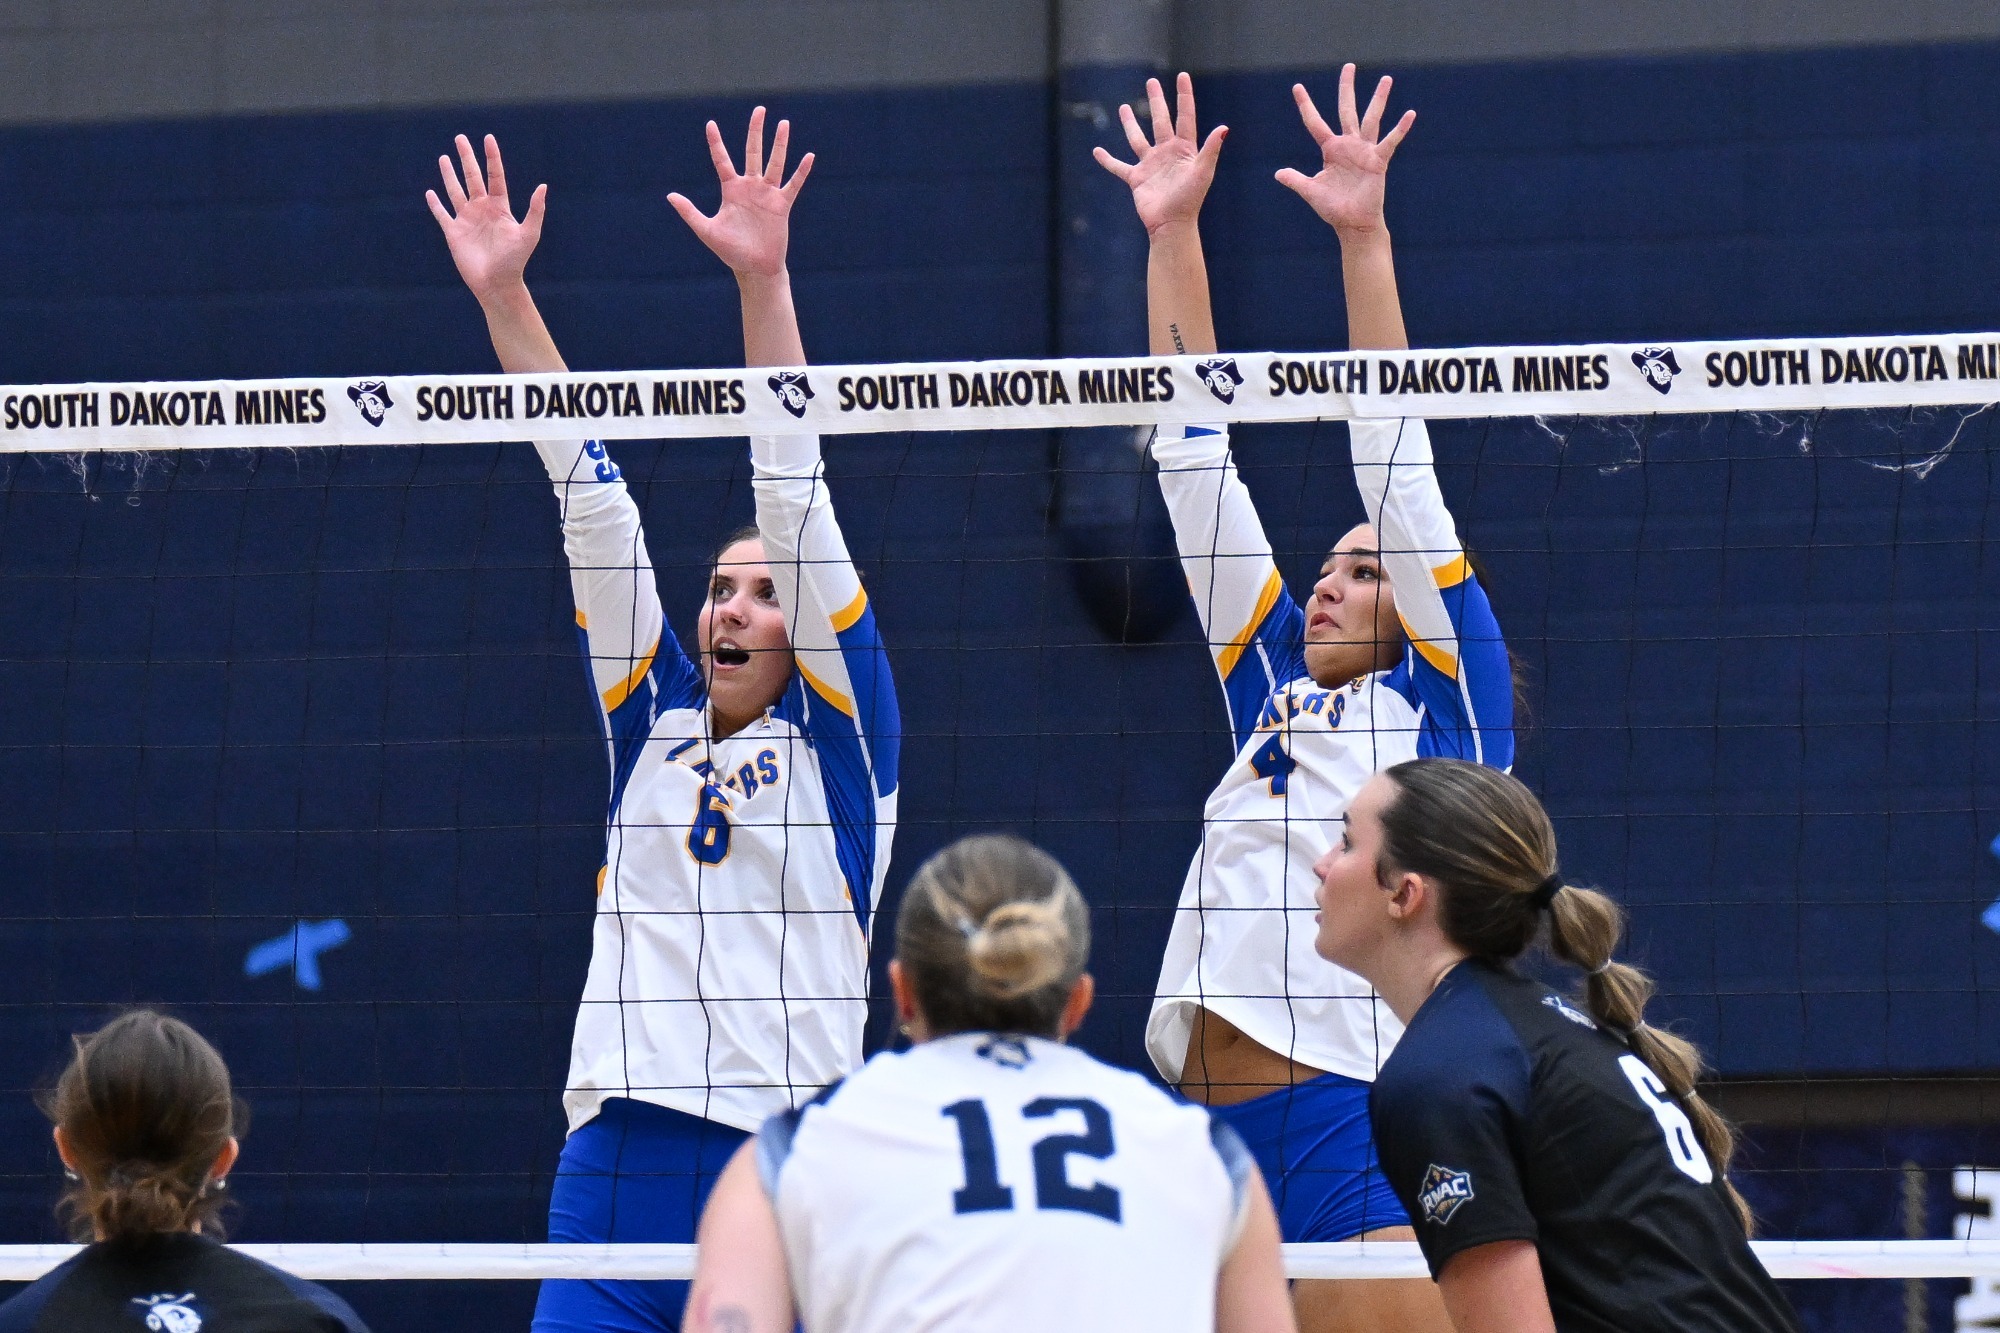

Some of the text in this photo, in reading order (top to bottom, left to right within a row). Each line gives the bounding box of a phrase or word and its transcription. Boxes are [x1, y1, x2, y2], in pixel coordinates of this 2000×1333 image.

[1267, 355, 1610, 397] SOUTH DAKOTA MINES
[1706, 344, 2000, 388] SOUTH DAKOTA MI
[4, 389, 327, 430] SOUTH DAKOTA MINES
[416, 380, 746, 422] SOUTH DAKOTA MINES
[838, 367, 1175, 412] SOUTH DAKOTA MINES
[1249, 730, 1299, 799] 4
[686, 783, 733, 867] 6
[1617, 1054, 1713, 1184] 6
[940, 1096, 1123, 1225] 12
